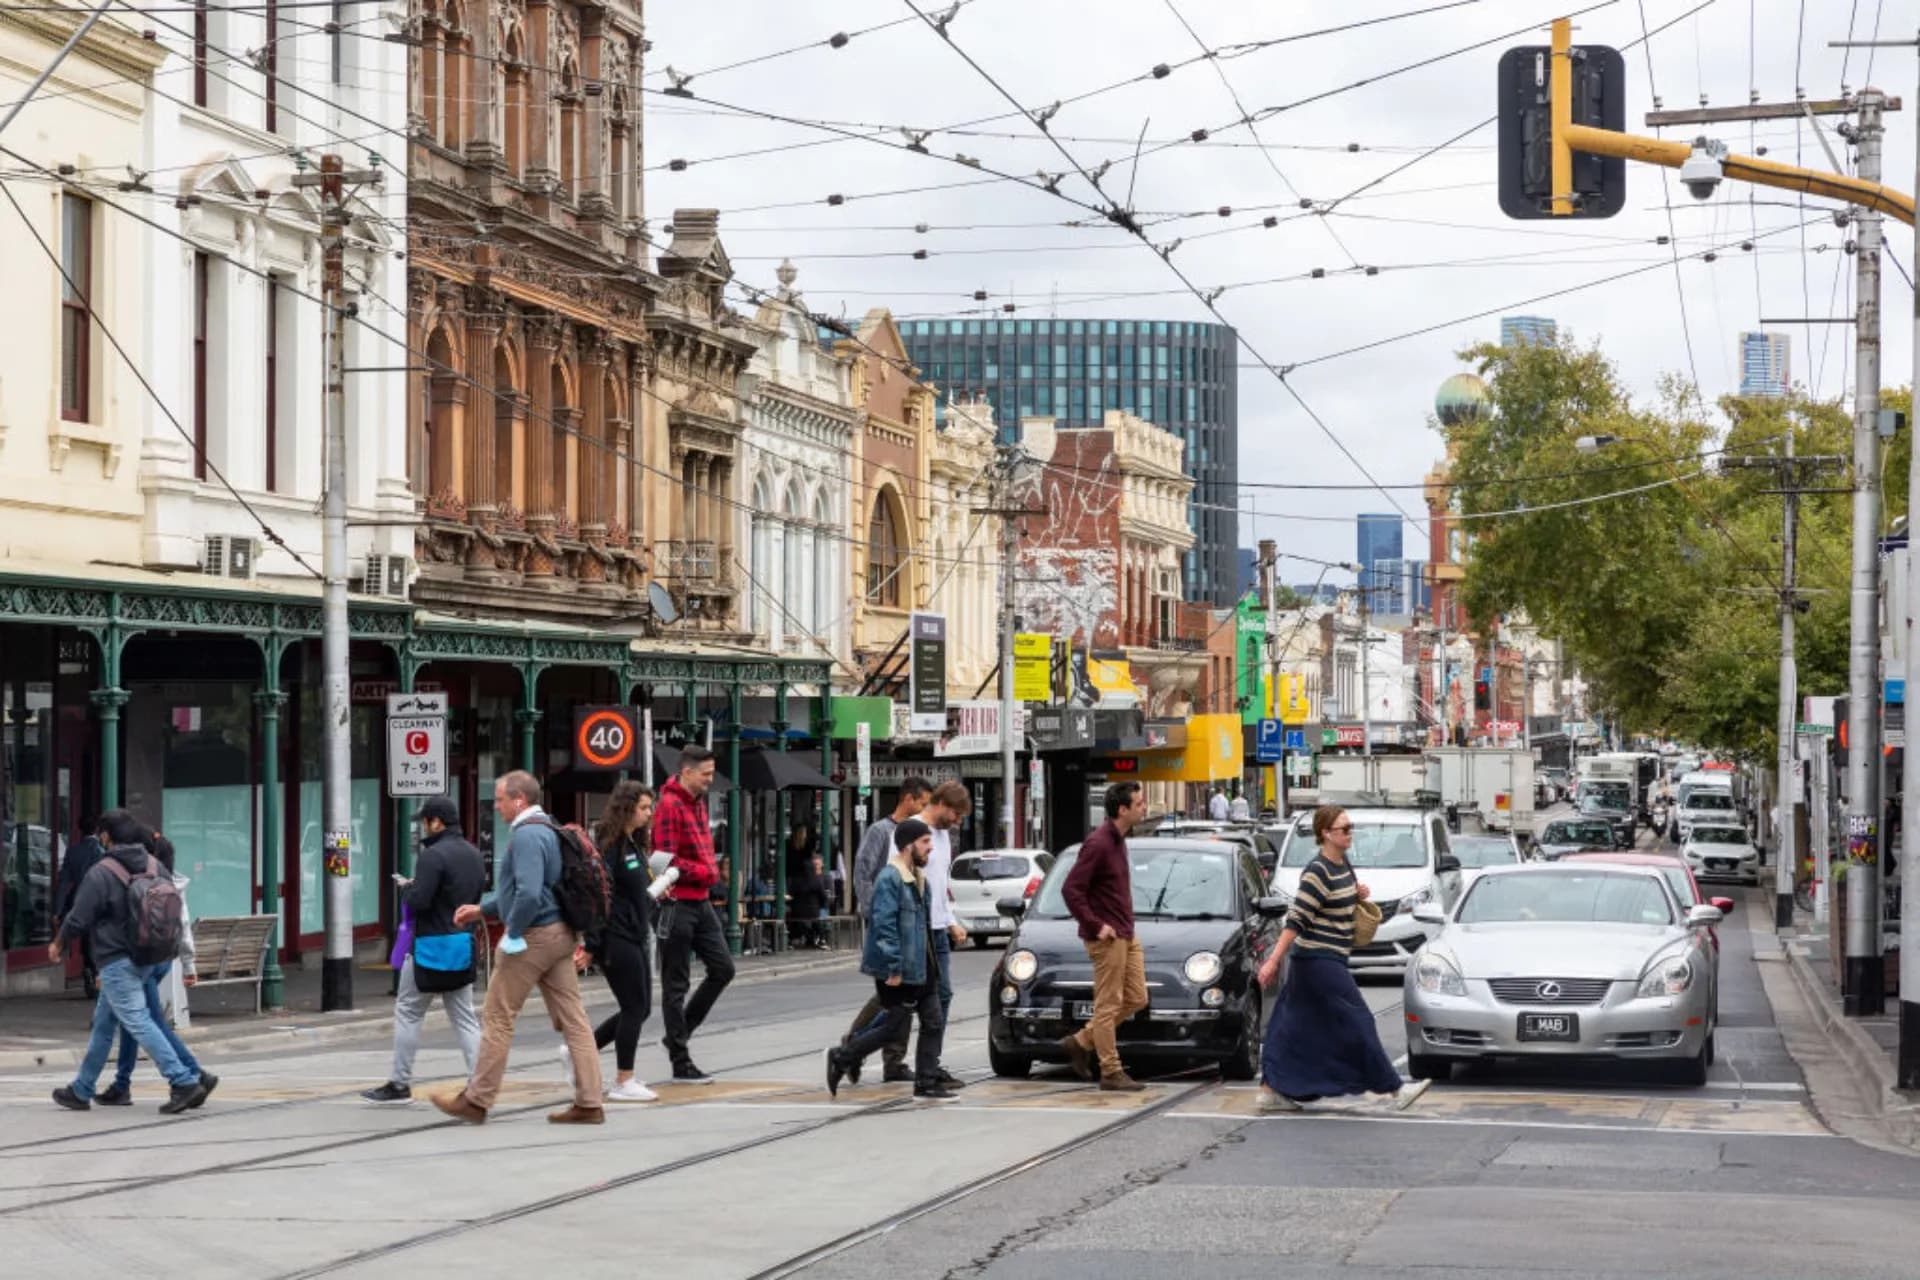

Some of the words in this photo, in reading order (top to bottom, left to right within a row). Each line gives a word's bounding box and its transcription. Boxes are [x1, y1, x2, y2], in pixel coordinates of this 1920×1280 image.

[391, 720, 441, 729] CLEARWAY
[1263, 720, 1278, 742] P
[410, 732, 425, 754] C
[590, 726, 624, 750] 40
